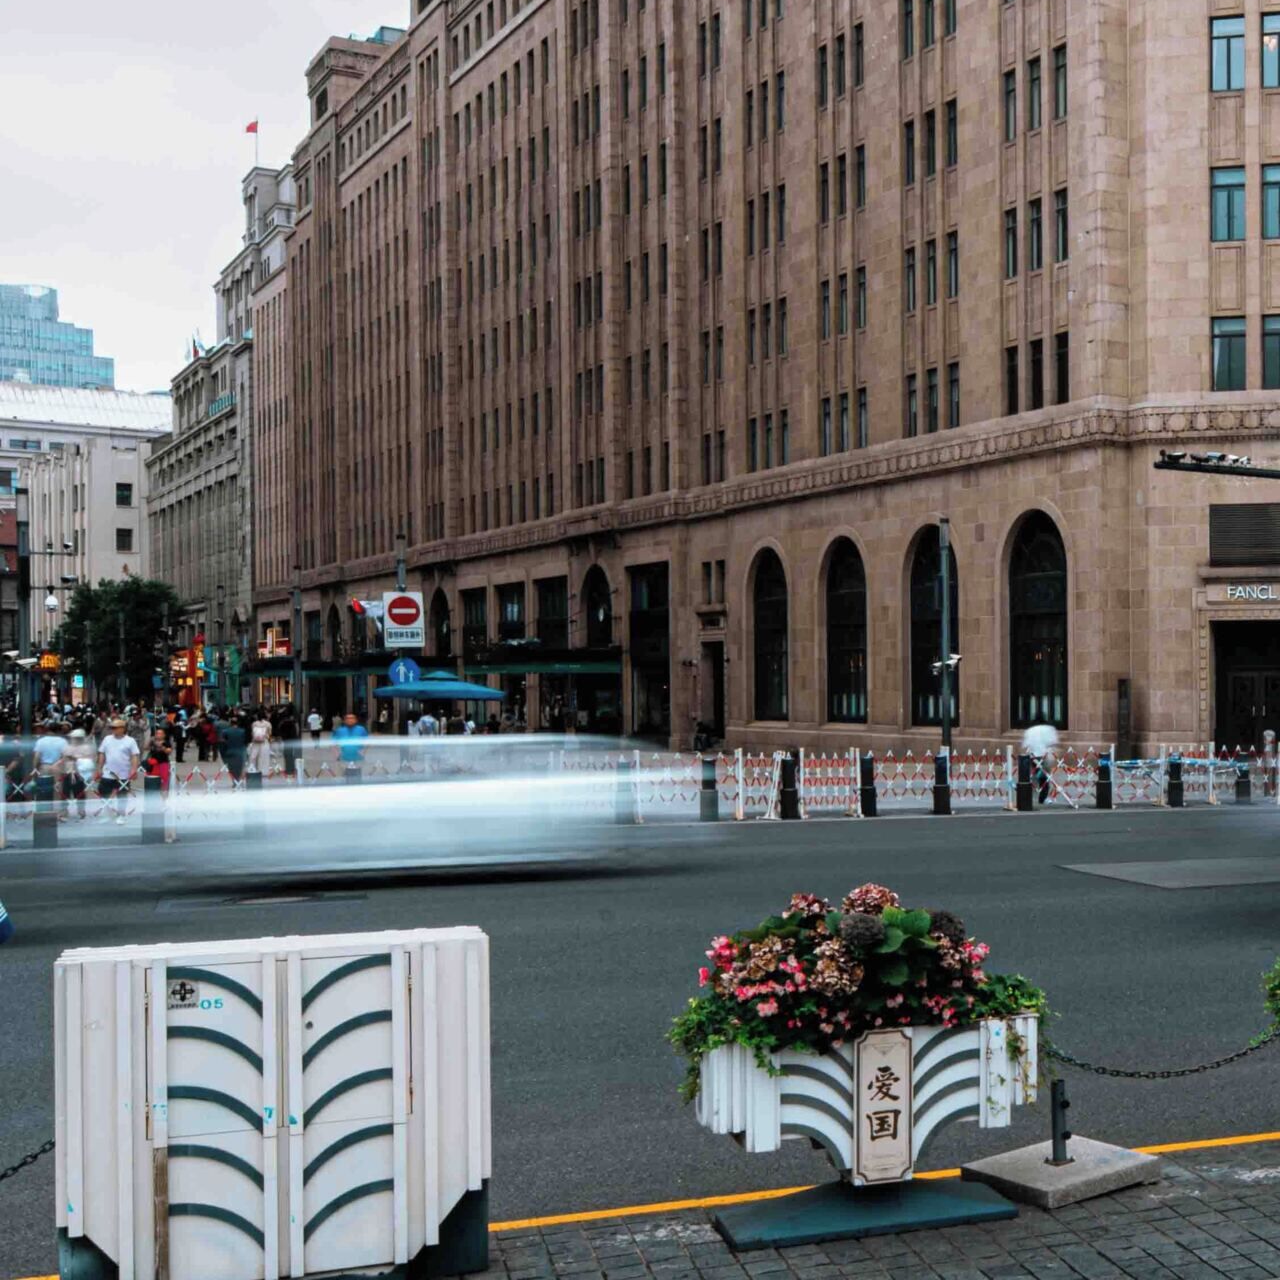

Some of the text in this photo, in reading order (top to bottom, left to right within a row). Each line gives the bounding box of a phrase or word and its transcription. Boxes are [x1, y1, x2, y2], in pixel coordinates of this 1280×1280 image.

[1227, 585, 1278, 599] FANCL
[199, 997, 224, 1010] 05
[866, 1065, 902, 1142] 爱国
